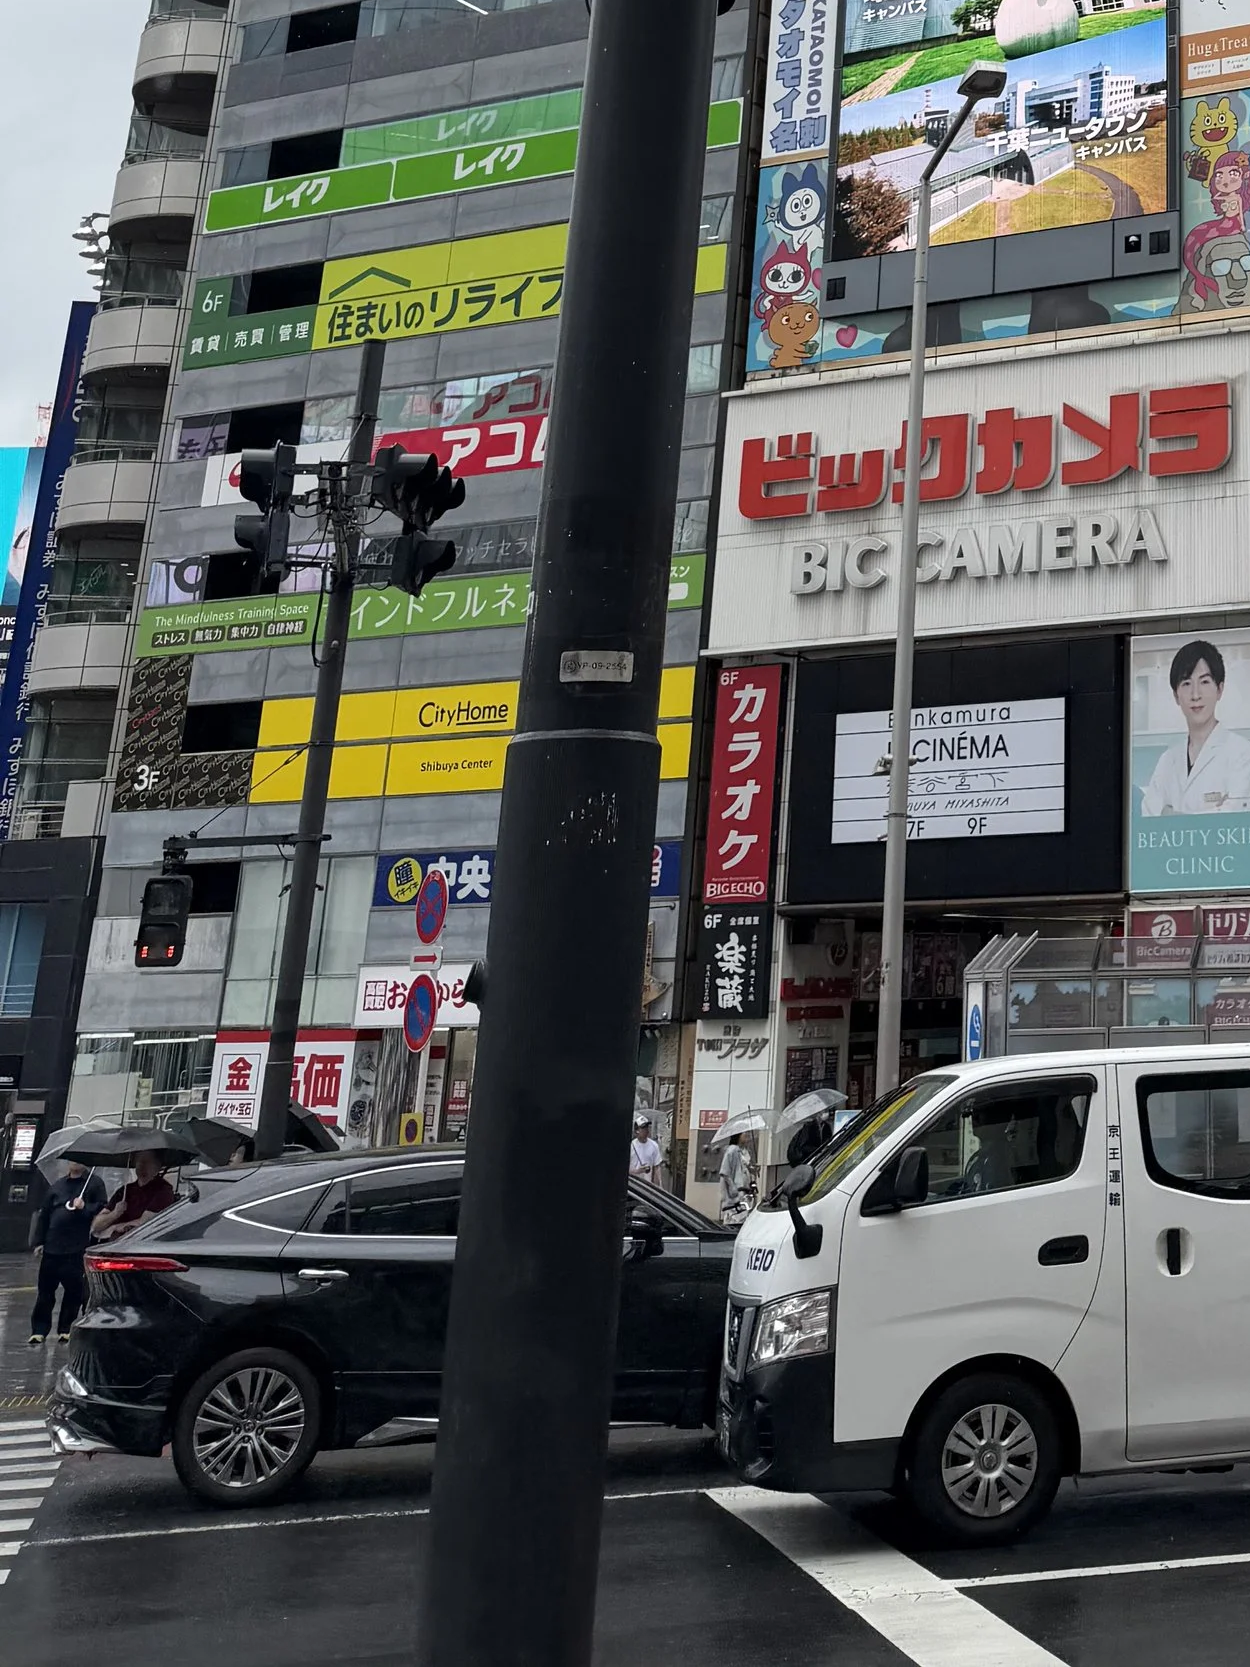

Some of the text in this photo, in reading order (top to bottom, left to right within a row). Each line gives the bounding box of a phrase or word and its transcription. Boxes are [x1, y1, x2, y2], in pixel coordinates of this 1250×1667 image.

[986, 111, 1149, 156] 千葉ニュータウン
[1075, 135, 1149, 161] キャンパス
[454, 143, 526, 180] レイク
[263, 177, 331, 213] レイク
[202, 294, 224, 314] 6F
[279, 321, 310, 343] 管理
[738, 382, 1233, 520] ビックカメラ
[791, 509, 1168, 595] BIC CAMERA
[155, 604, 309, 627] The Mindfulness Training Space
[350, 583, 534, 631] インドフルネ
[720, 671, 739, 686] 6F
[418, 700, 508, 728] CityHome
[912, 731, 1010, 763] CINÉMA
[134, 764, 160, 791] 3F
[421, 756, 493, 773] Shibuya Center
[718, 683, 767, 871] カラオケ
[945, 797, 1010, 809] MIYASHITA
[967, 817, 988, 835] 9F
[1138, 829, 1211, 849] BEAUTY
[1166, 856, 1234, 875] CLINIC
[704, 914, 722, 929] 6F
[1136, 946, 1192, 957] BicCamera
[225, 1056, 253, 1092] 金
[1108, 1124, 1122, 1208] 京王運輸
[747, 1246, 775, 1272] KEIO
